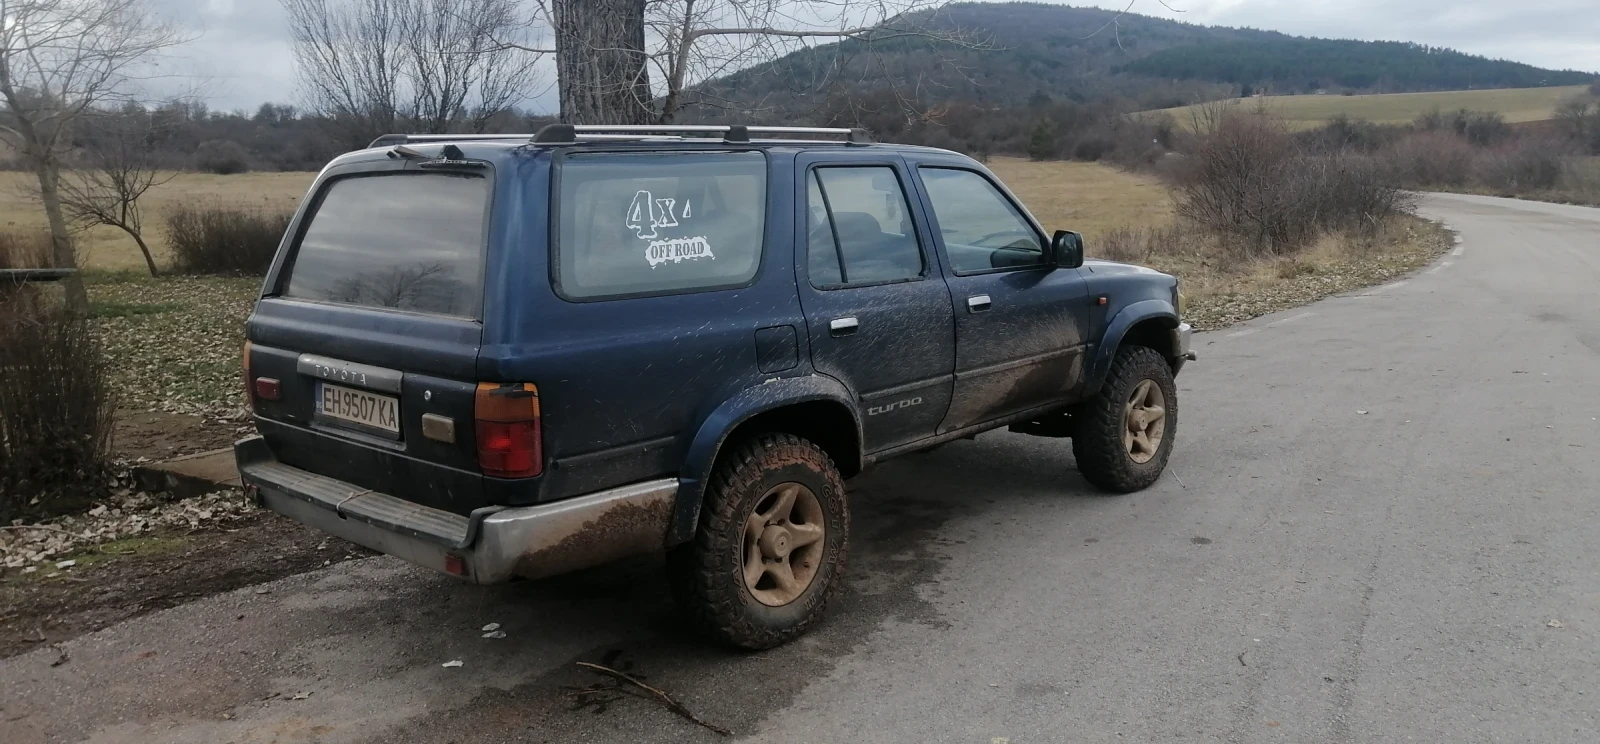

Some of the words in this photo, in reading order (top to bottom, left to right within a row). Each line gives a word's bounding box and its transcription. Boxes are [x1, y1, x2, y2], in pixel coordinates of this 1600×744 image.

[650, 243, 673, 259] OFF
[674, 241, 705, 257] ROAD
[315, 364, 366, 385] TOYOTA
